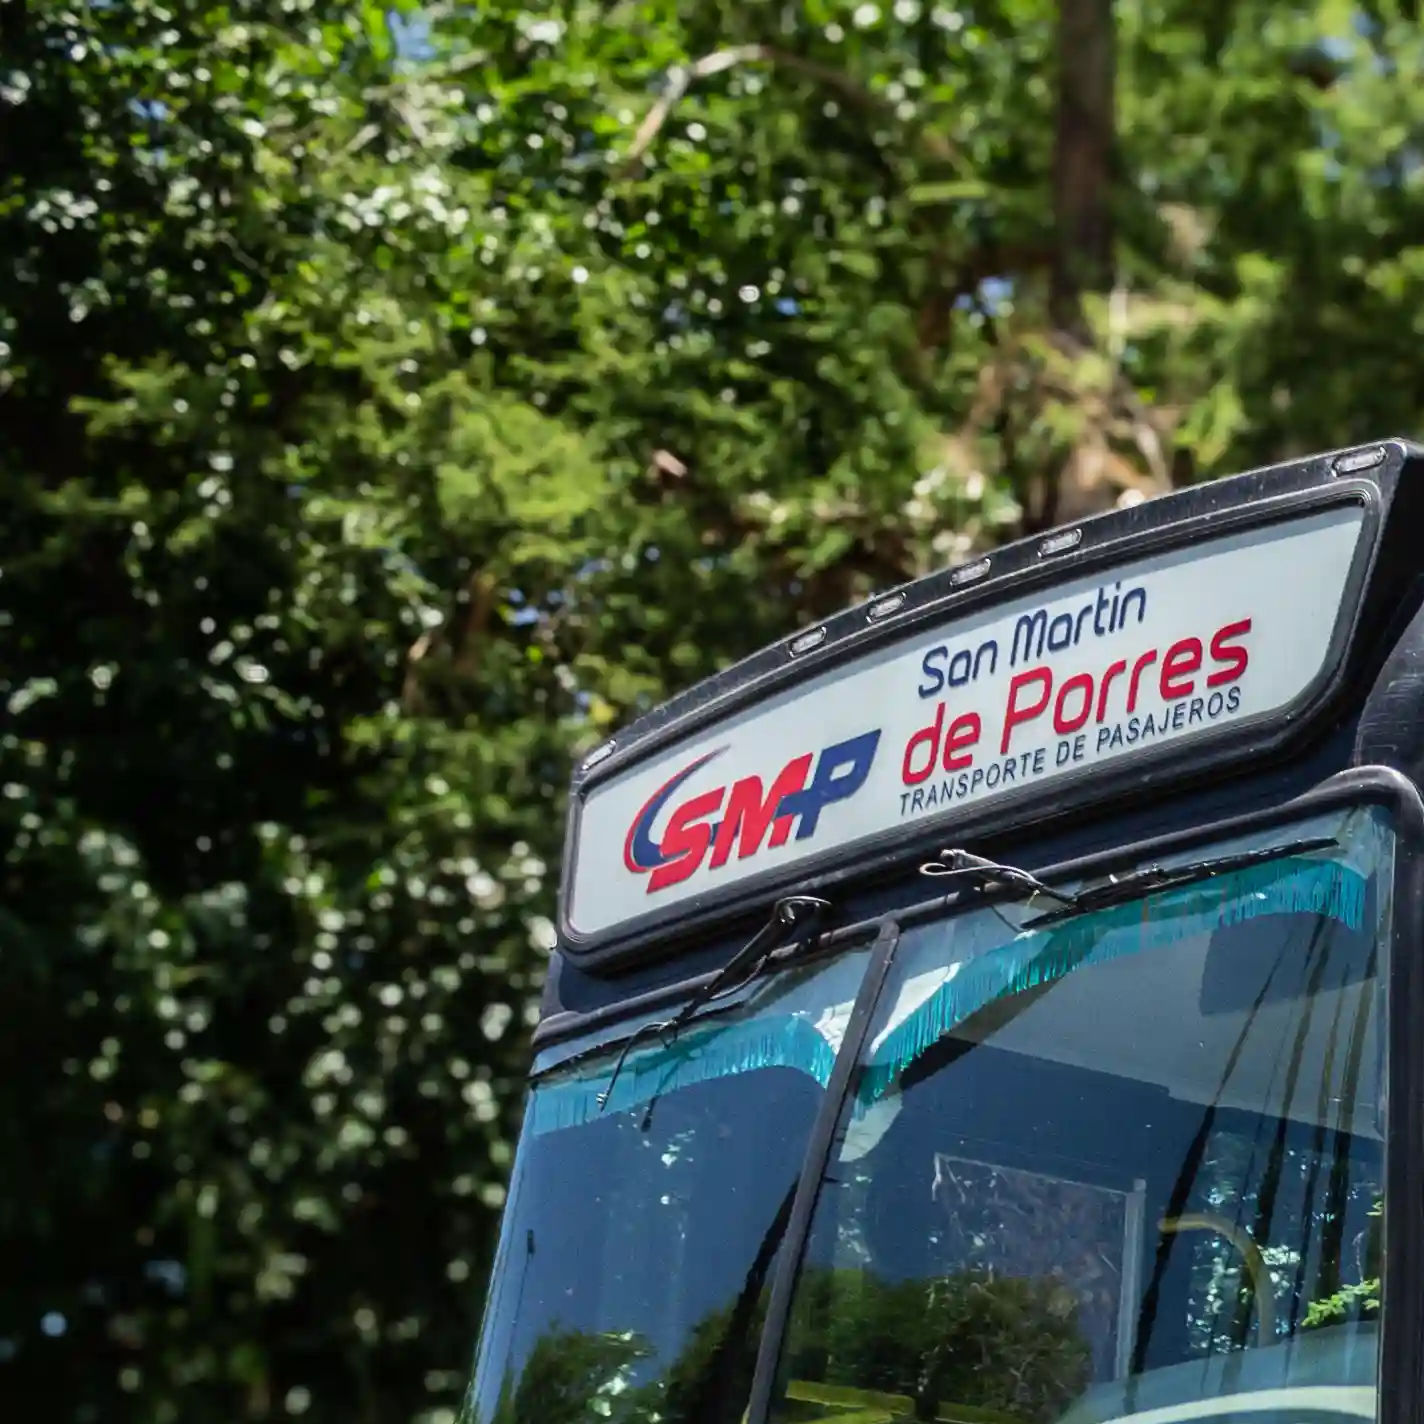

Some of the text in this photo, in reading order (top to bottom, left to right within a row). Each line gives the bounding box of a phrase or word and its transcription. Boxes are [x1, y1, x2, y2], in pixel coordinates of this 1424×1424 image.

[902, 617, 1252, 785] de Porres
[918, 582, 1146, 699] San Martin
[646, 728, 882, 894] SMP
[900, 686, 1241, 816] TRANSPORTE DE PASAJEROS
